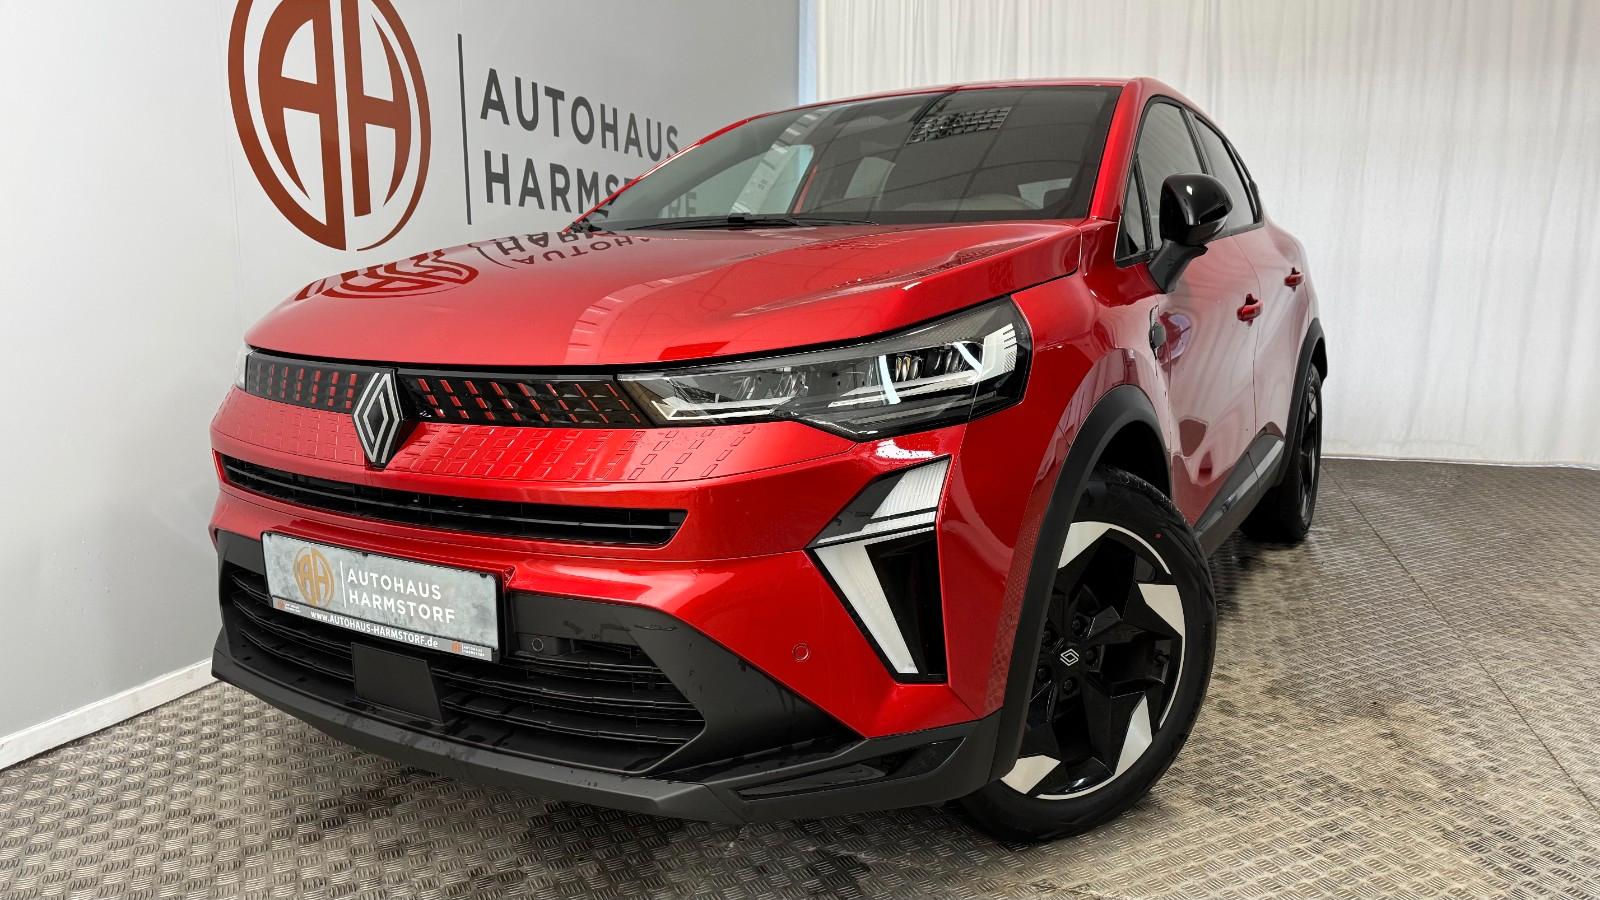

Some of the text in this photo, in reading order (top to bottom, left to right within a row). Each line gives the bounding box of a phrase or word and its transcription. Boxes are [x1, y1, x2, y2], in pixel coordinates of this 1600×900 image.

[480, 68, 679, 162] AUTOHAUS
[347, 568, 442, 600] AUTOHAUS
[349, 590, 456, 624] HARMSTORF
[310, 610, 439, 648] www.AUTOHAUS-HARMSTORF.de
